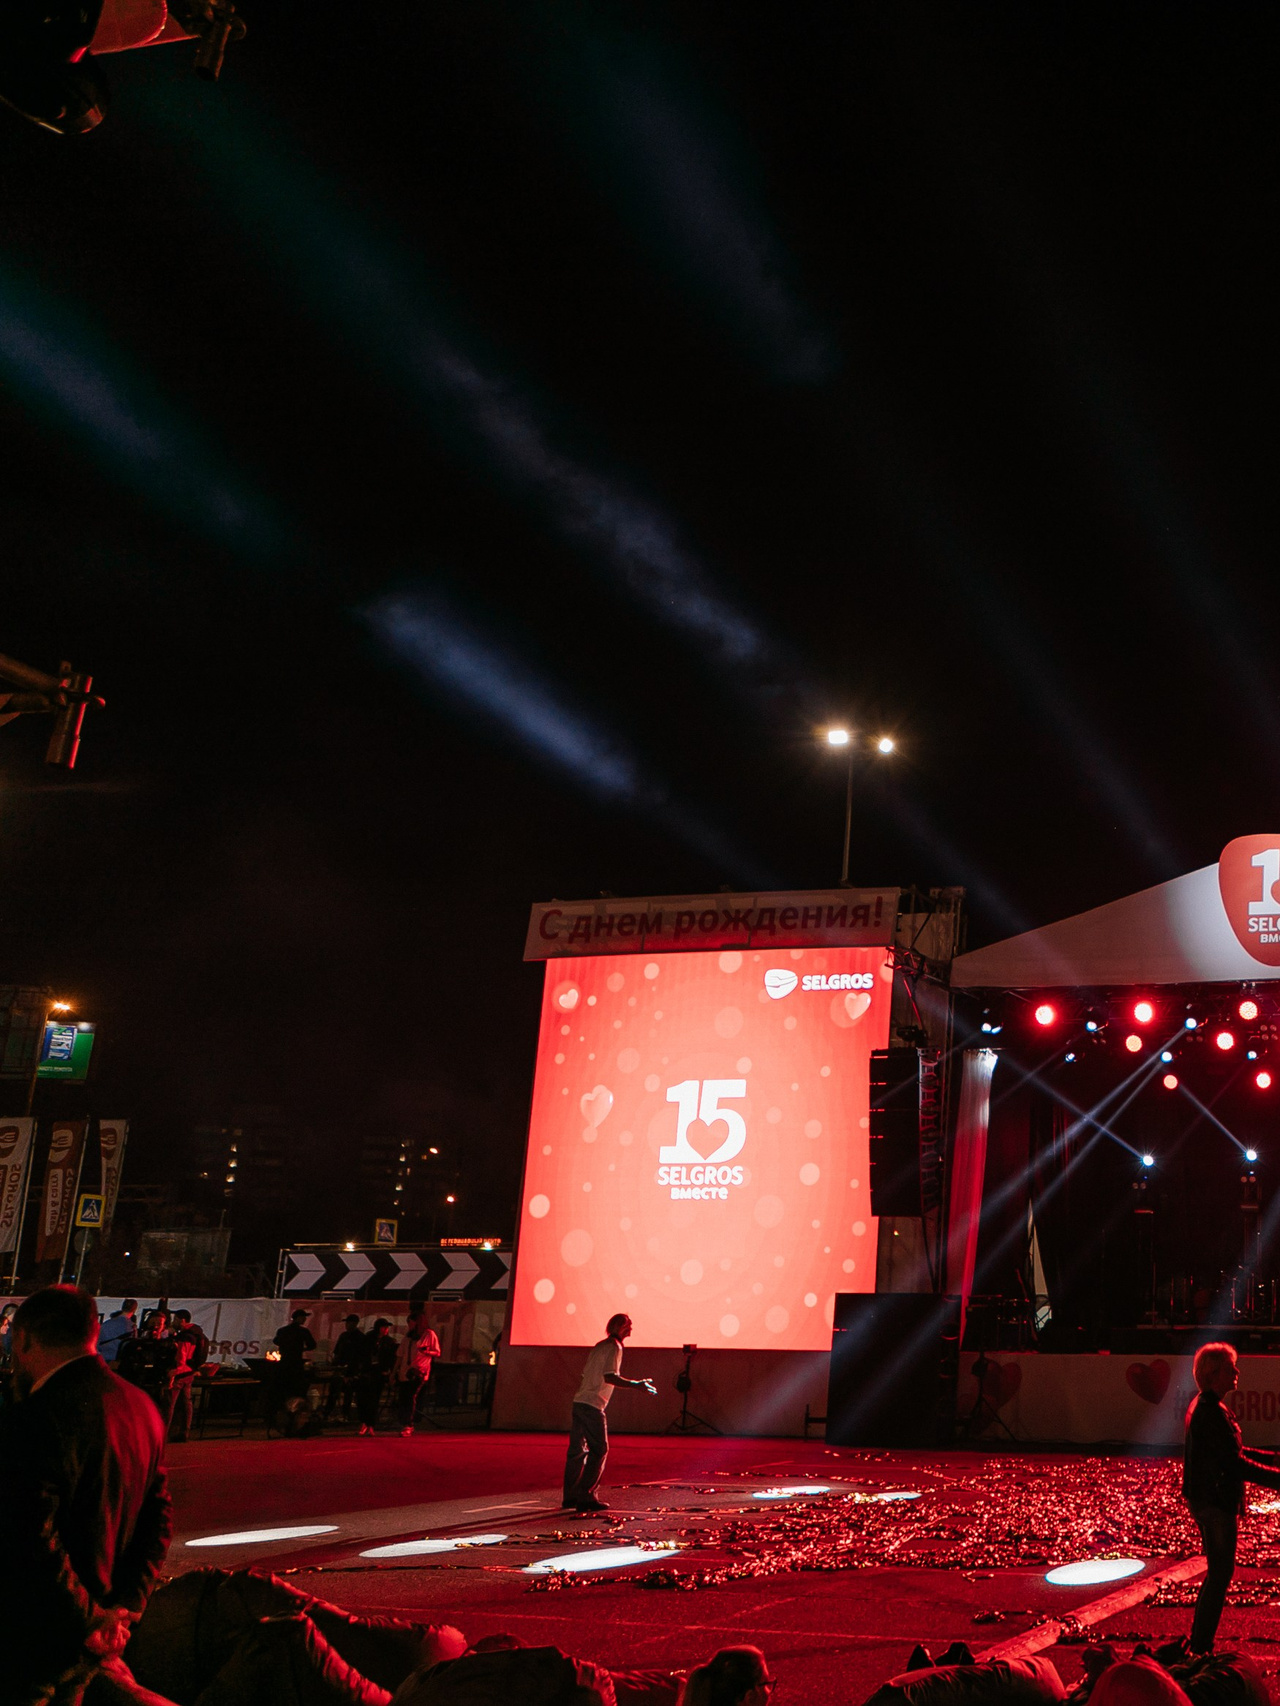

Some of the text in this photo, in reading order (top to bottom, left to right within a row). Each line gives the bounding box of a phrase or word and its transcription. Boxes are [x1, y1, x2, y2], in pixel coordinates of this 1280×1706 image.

[539, 896, 883, 943] С днем рождения!
[802, 973, 874, 991] SELGROS
[659, 1079, 747, 1164] 15
[657, 1166, 744, 1186] SELGROS
